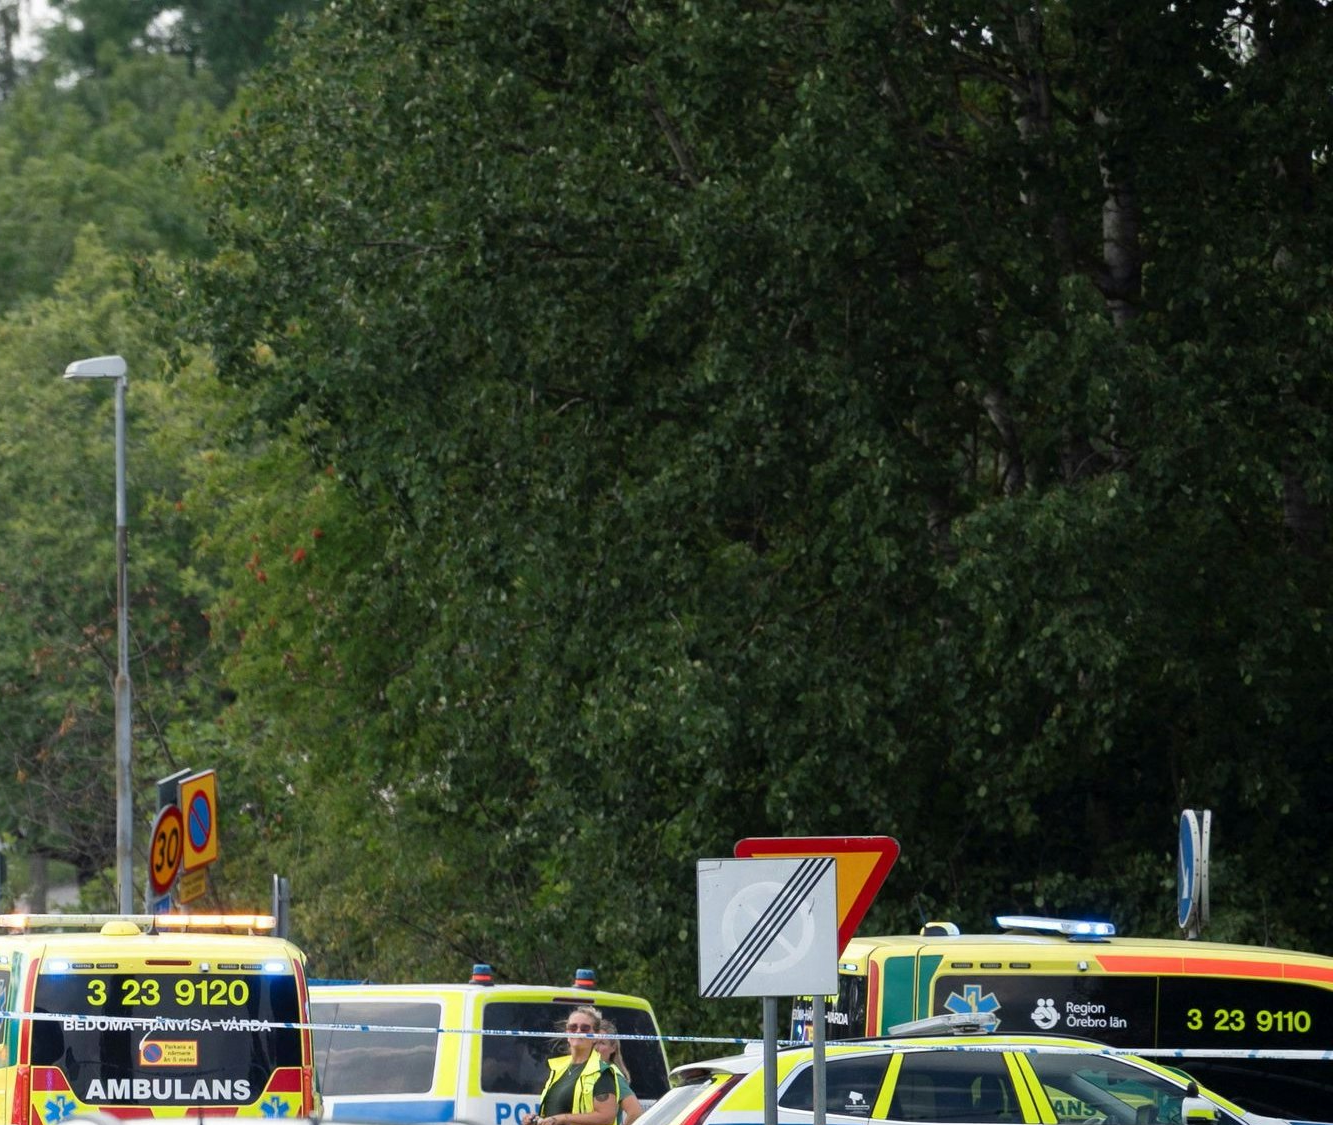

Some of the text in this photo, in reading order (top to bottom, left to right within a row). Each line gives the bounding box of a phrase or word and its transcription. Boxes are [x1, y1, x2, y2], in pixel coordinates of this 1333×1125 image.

[155, 828, 179, 873] 30
[86, 979, 249, 1006] 3 23 9120
[1065, 1001, 1106, 1015] Region
[1066, 1014, 1127, 1029] Örebro län
[1187, 1008, 1312, 1033] 3 23 9110
[85, 1078, 251, 1100] AMBULANS
